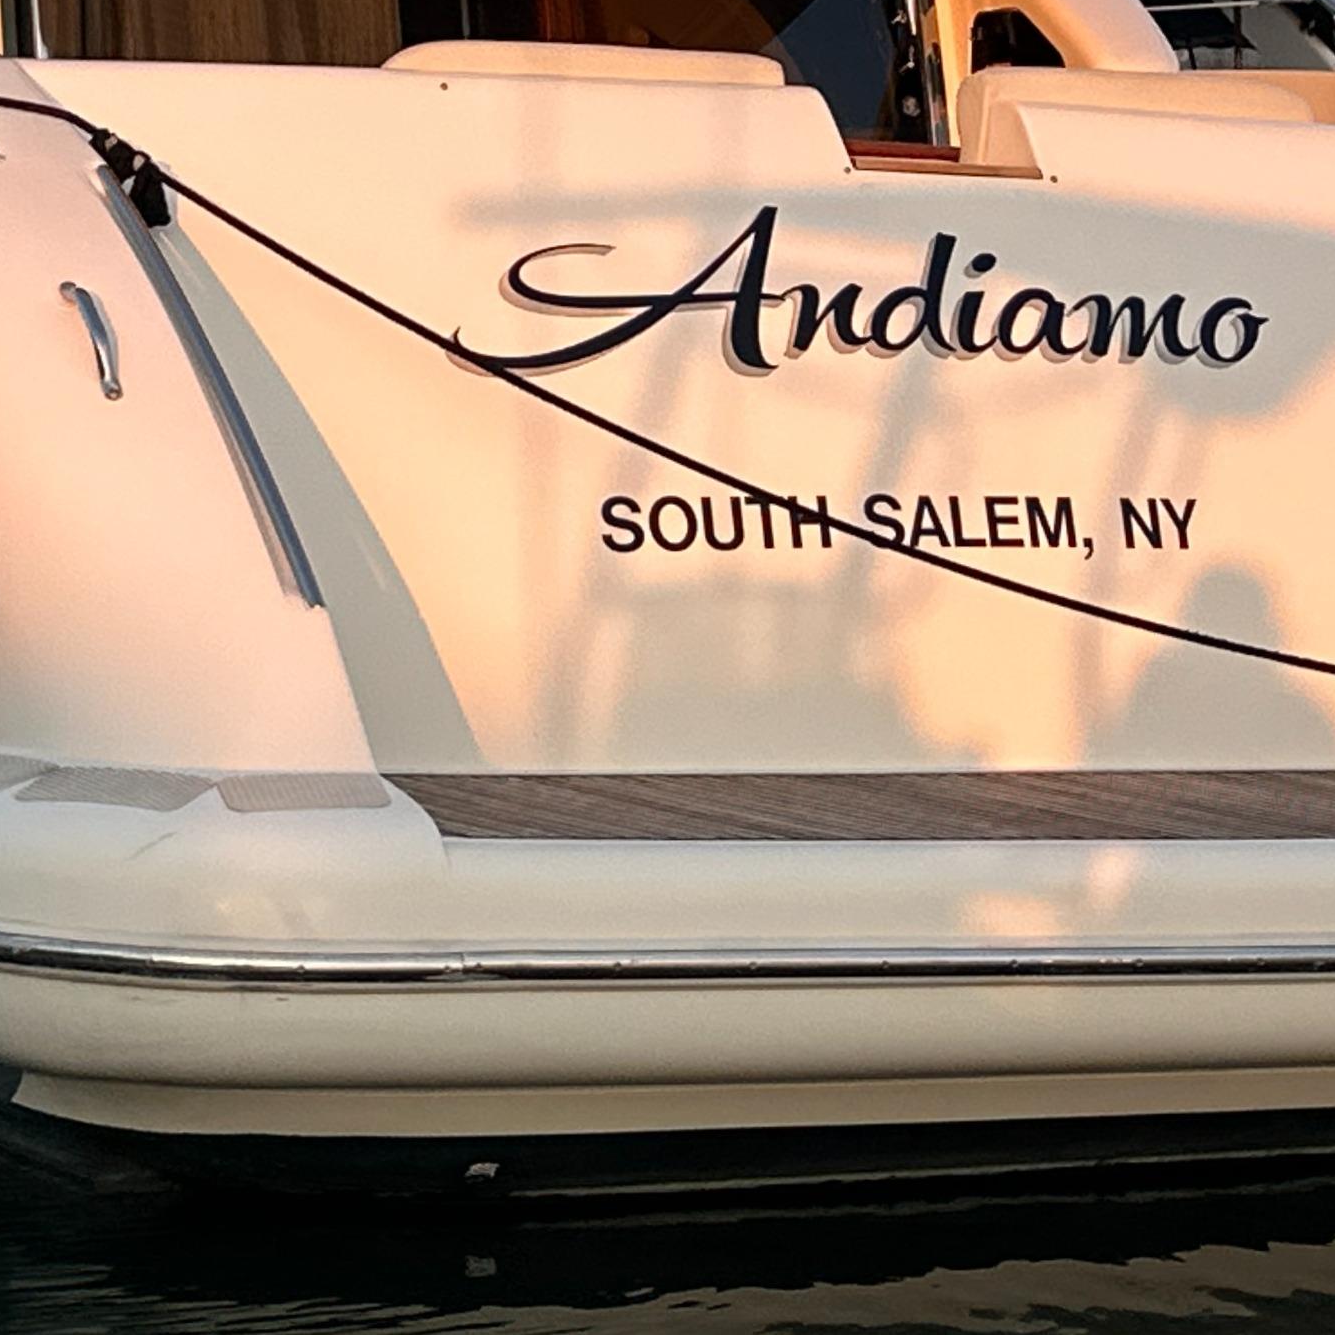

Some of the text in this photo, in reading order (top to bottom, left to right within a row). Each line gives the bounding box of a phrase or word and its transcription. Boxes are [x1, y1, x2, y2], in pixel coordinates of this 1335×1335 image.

[453, 205, 1269, 373] Andiamo
[601, 493, 1198, 560] SOUTH SALEM, NY
